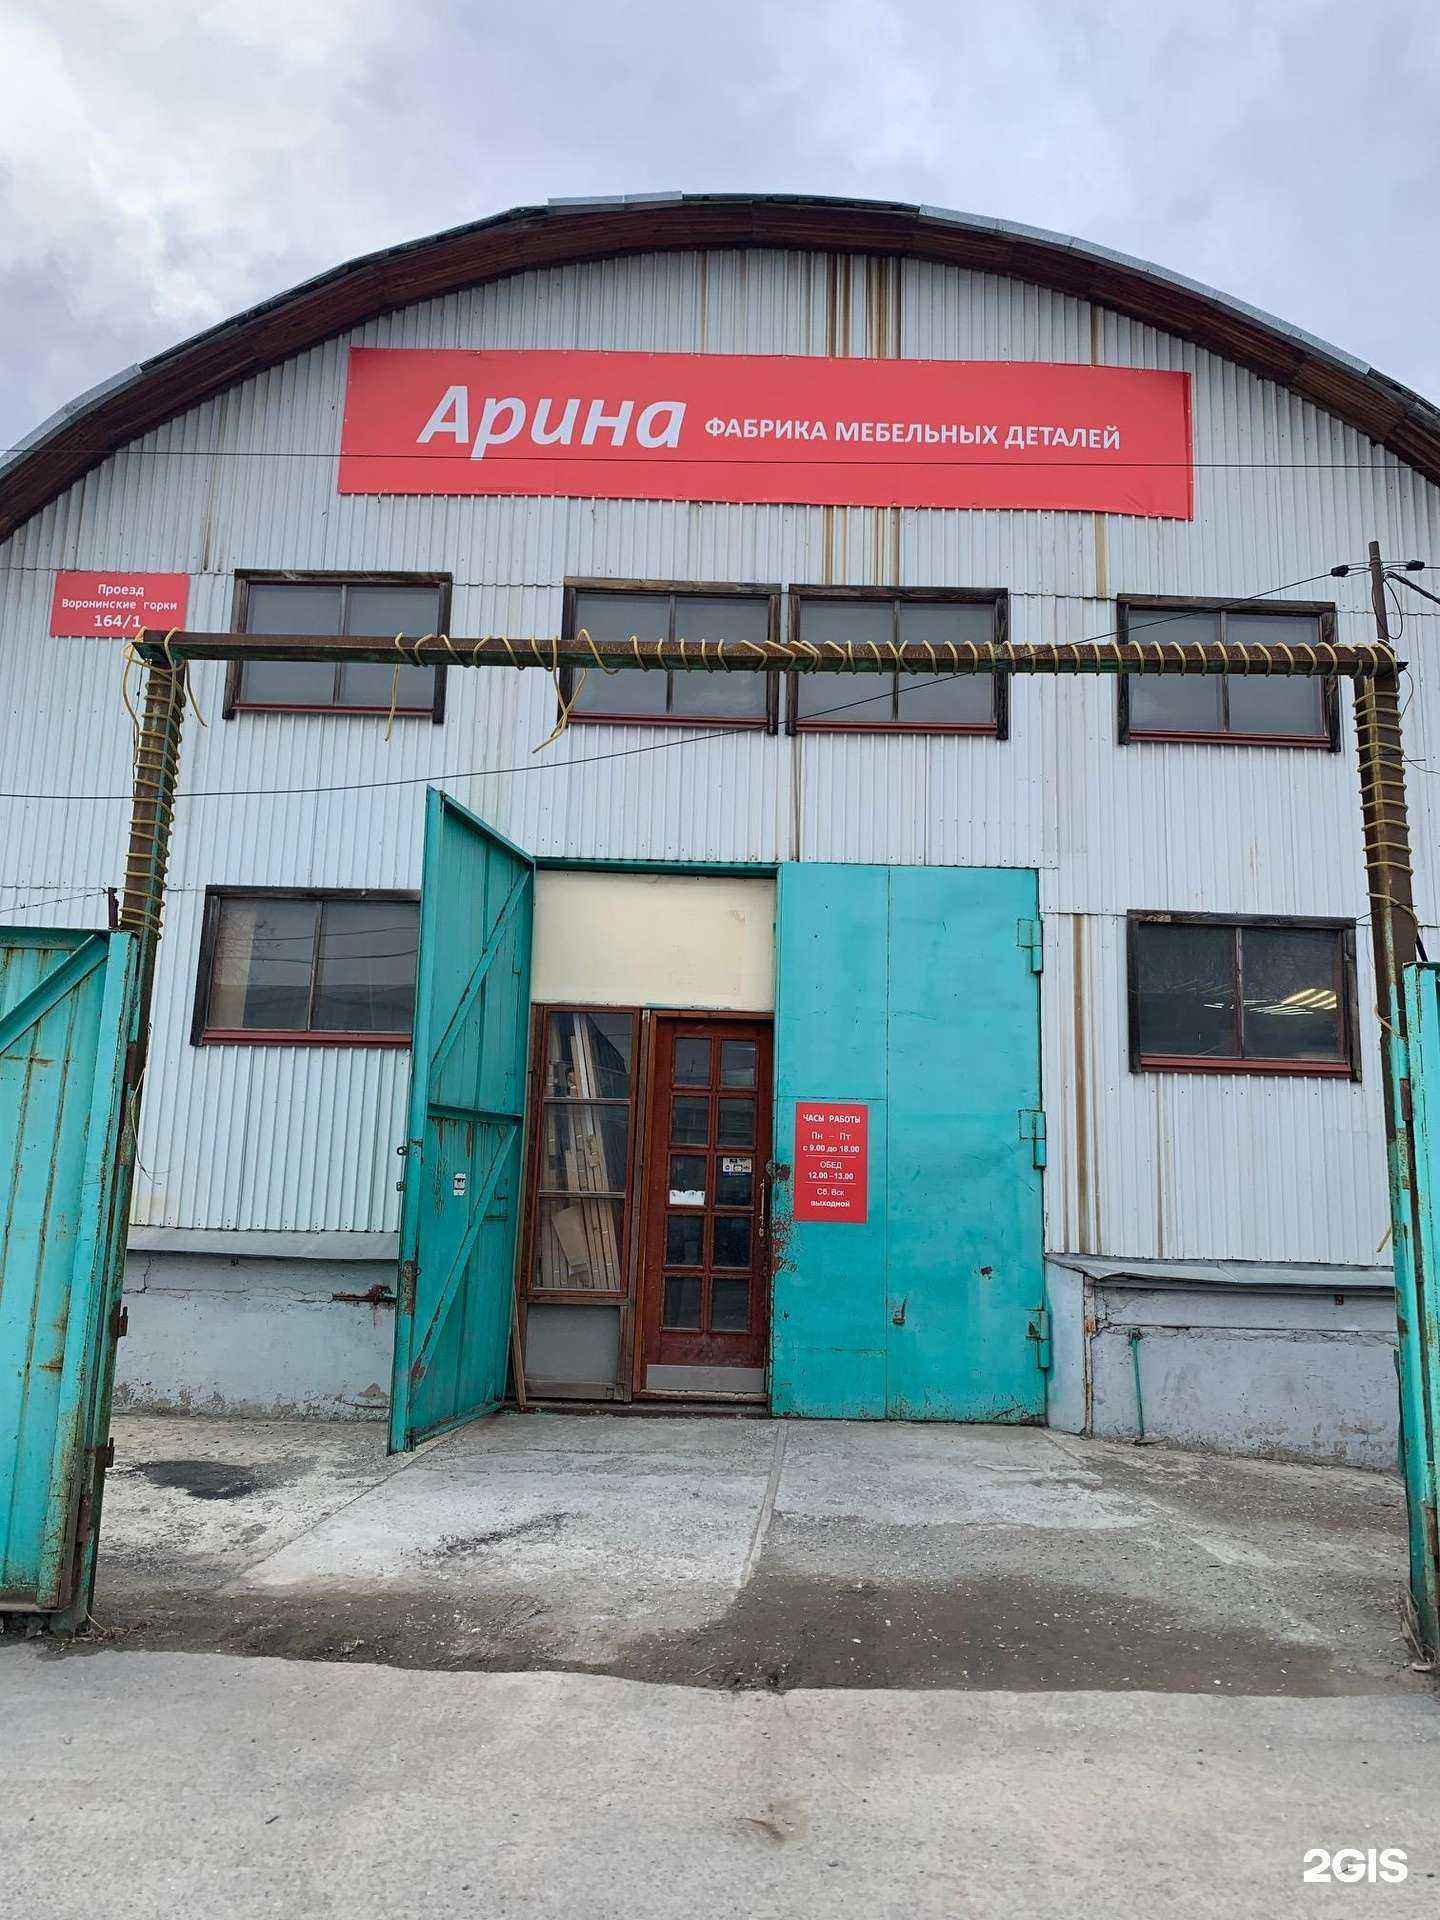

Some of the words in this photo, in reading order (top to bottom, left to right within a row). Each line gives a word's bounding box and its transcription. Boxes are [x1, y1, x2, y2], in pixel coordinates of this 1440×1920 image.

[416, 385, 687, 460] Арина
[704, 417, 828, 441] ФАБРИКА
[835, 422, 998, 445] МЕБЕЛЬНЫХ
[1004, 425, 1120, 450] ДЕТАЛЕЙ
[97, 583, 145, 597] Проезд
[62, 598, 136, 610] Воронинские
[143, 602, 178, 612] горки
[94, 614, 141, 629] 164/1
[803, 1114, 824, 1122] ЧАСЫ
[829, 1115, 860, 1123] РАБОТЫ
[811, 1131, 823, 1140] Пн
[840, 1132, 851, 1140] Пт
[809, 1144, 826, 1152] 9.00
[826, 1145, 838, 1153] до
[840, 1145, 860, 1153] 18.00
[820, 1161, 842, 1170] ОБЕД
[810, 1200, 851, 1208] выходной
